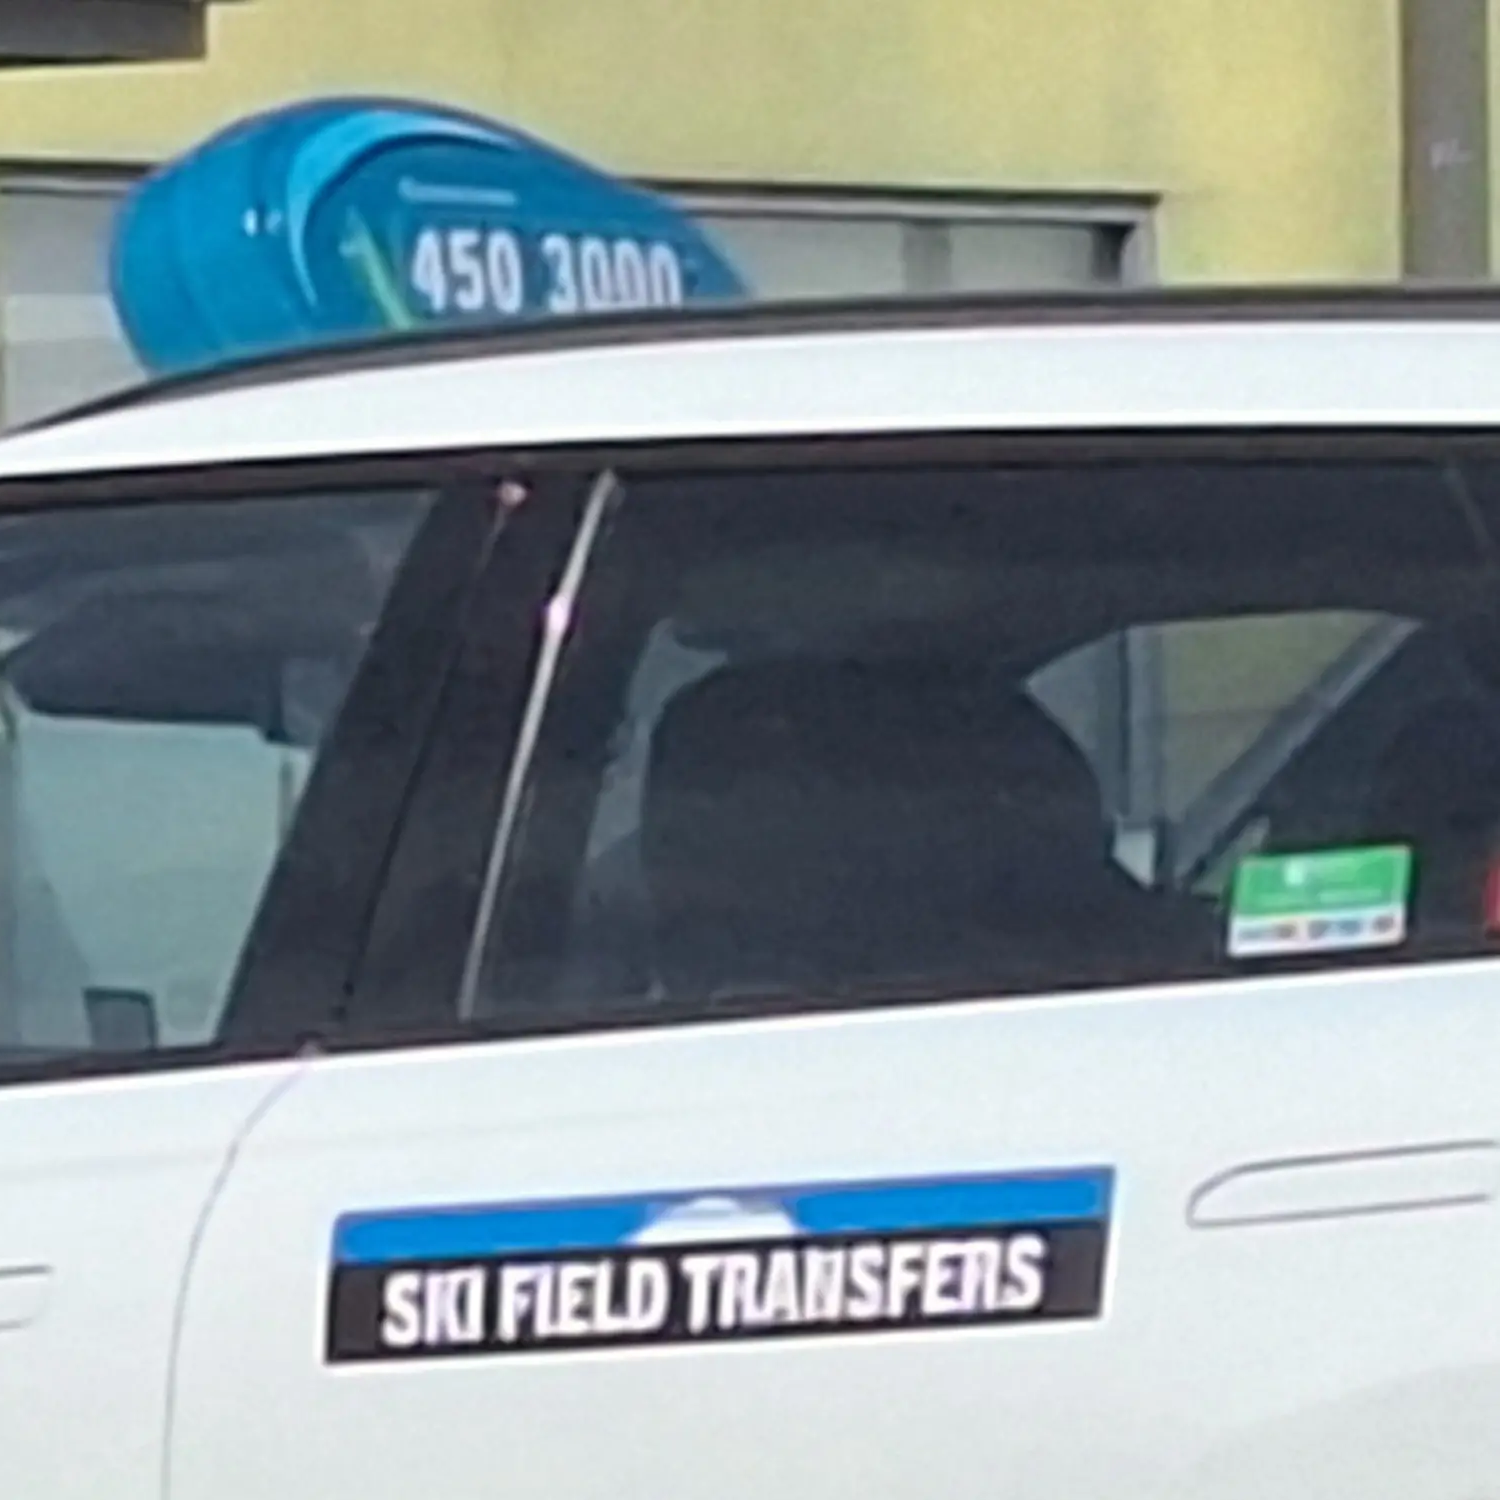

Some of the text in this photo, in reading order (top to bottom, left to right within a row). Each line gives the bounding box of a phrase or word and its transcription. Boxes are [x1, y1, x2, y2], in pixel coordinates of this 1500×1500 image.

[412, 227, 683, 313] 450 3000
[381, 1236, 1046, 1348] SKI FIELD TRANSFERS
